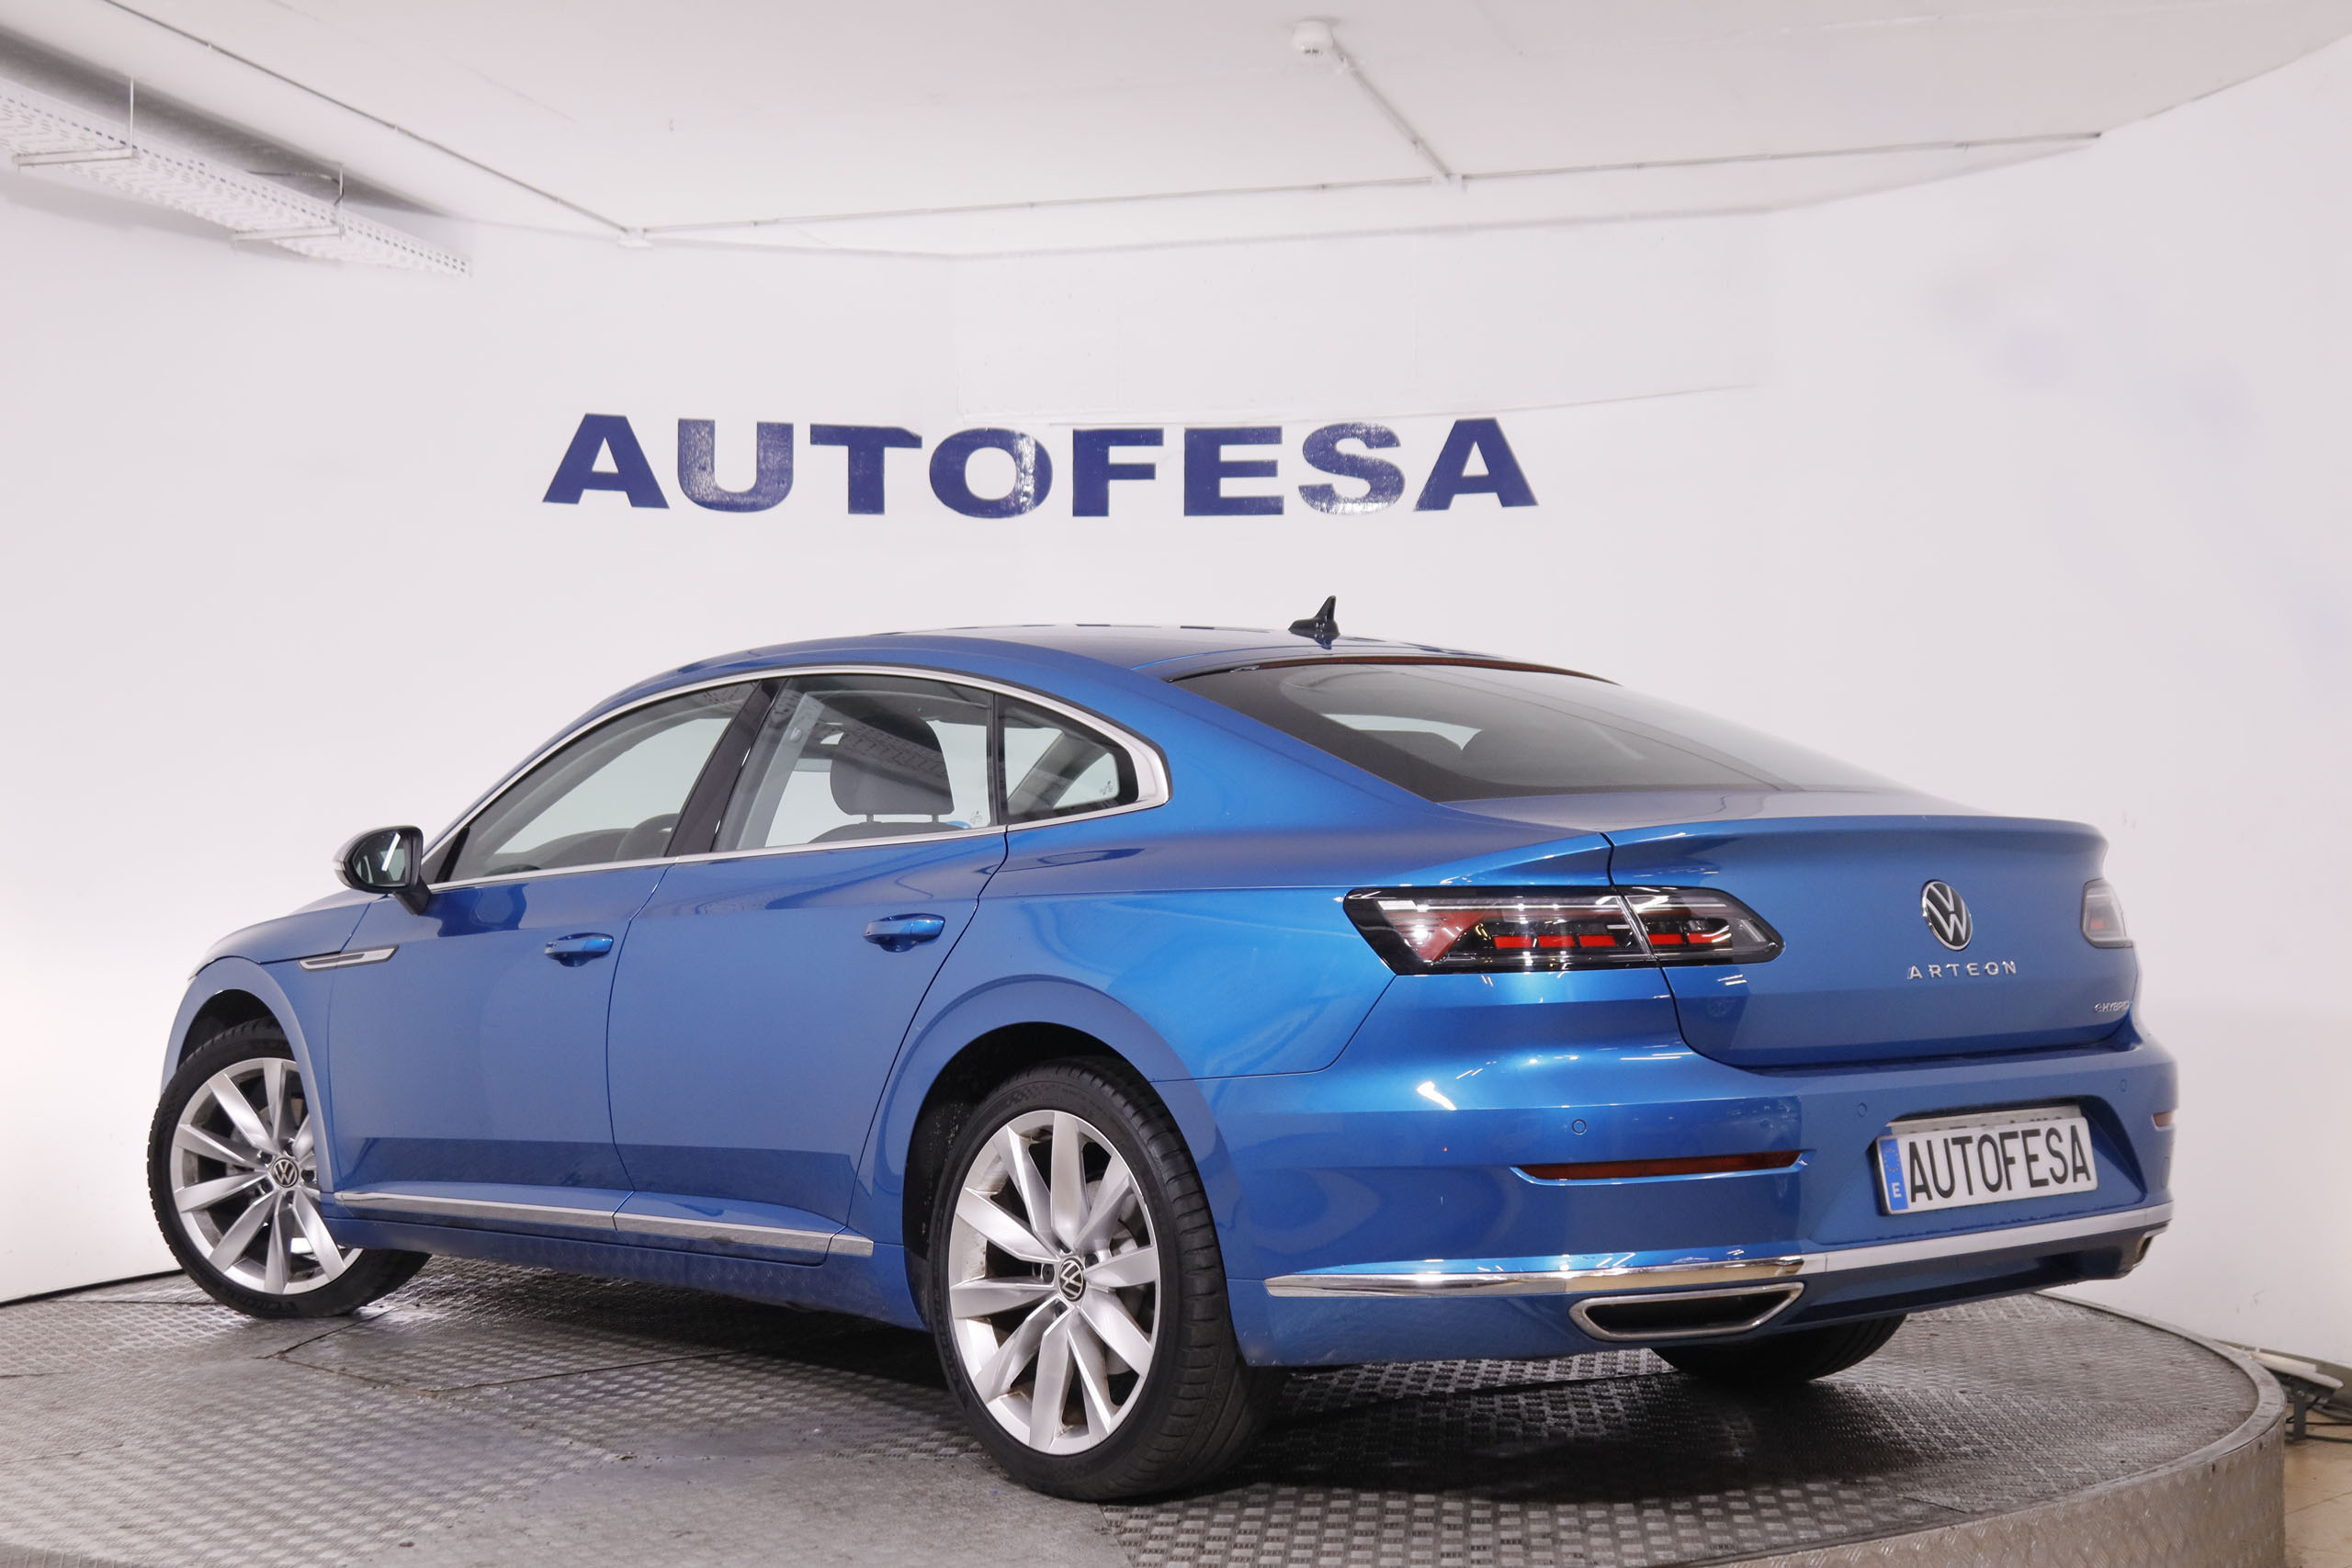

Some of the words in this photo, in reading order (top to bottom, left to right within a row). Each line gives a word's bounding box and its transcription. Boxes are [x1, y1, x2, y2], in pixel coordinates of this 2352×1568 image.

[543, 412, 1538, 518] AUTOFESA
[1907, 961, 2017, 979] ARTEON
[1909, 1124, 2091, 1202] AUTOFESA
[1891, 1182, 1902, 1198] E
